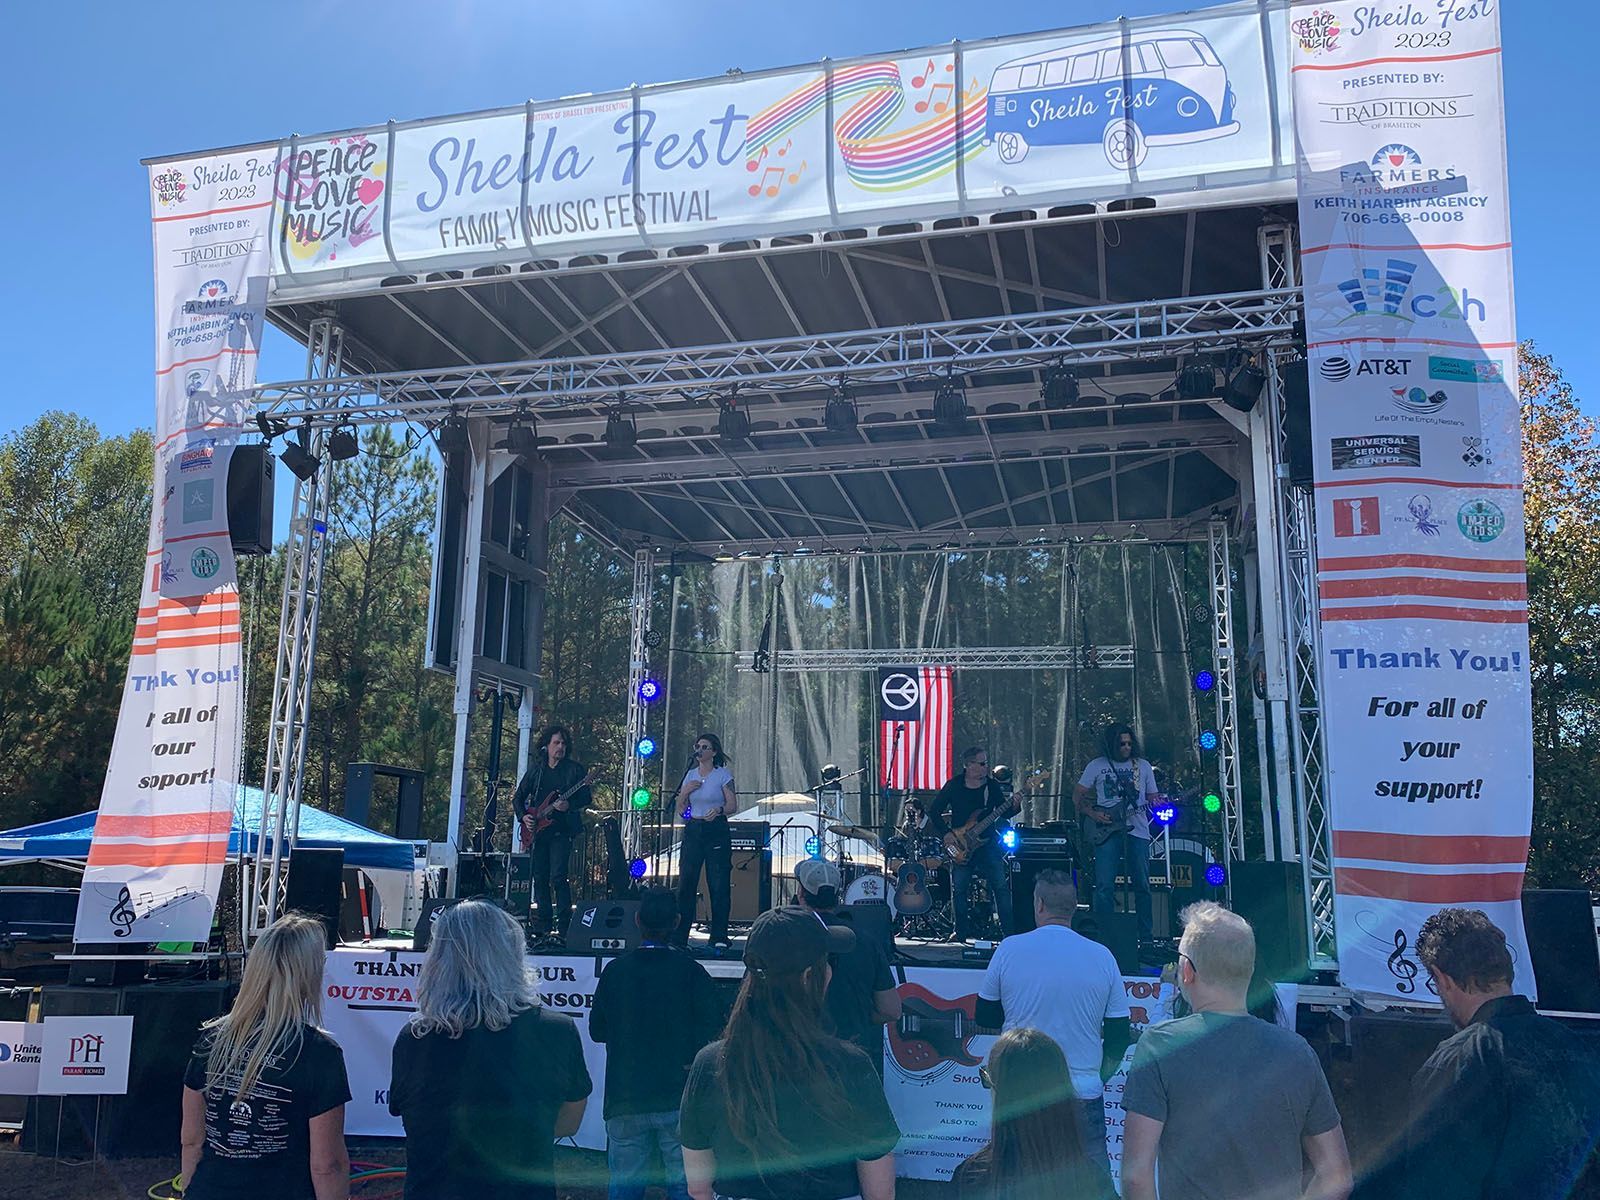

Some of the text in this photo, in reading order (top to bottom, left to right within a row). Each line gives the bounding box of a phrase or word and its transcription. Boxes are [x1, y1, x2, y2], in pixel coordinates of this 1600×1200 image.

[1351, 0, 1494, 36] Sheila Fest
[1301, 26, 1329, 39] LOVE
[1394, 31, 1452, 49] 2023
[1299, 37, 1336, 49] MUSIC
[1342, 73, 1445, 90] PRESENTED BY:
[1027, 84, 1159, 128] Sheila Fest
[1331, 100, 1457, 126] TRADITIONS
[416, 104, 749, 213] Sheila Fest
[192, 158, 278, 191] Sheila Fest
[1340, 167, 1457, 184] FARMERS
[218, 184, 257, 201] 2023
[295, 175, 363, 211] LOVE
[1358, 185, 1439, 196] INSURANCE
[1314, 196, 1488, 209] KEITH HARBIN AGENCY
[286, 205, 368, 242] MUSIC
[439, 191, 718, 249] FAMILY MUSIC FESTIVAL
[1341, 211, 1464, 225] 706-658-0008
[189, 219, 251, 236] PRESENTED BY:
[189, 319, 220, 333] HARBIN
[1356, 359, 1411, 376] AT&T
[1345, 437, 1407, 447] UNIVERSAL
[1354, 446, 1401, 456] SERVICE
[1355, 456, 1400, 465] CENTER
[1330, 648, 1520, 672] Thank You!
[186, 665, 240, 686] You!
[161, 707, 192, 725] all
[197, 705, 219, 723] of
[1368, 697, 1488, 719] For all of
[151, 741, 196, 756] our
[1400, 741, 1460, 762] your
[1374, 779, 1483, 803] support!
[327, 985, 414, 1002] OUTSTA
[935, 1101, 984, 1111] THANK YOU
[939, 1118, 978, 1127] ALSO TO:
[930, 1150, 955, 1158] SOUND
